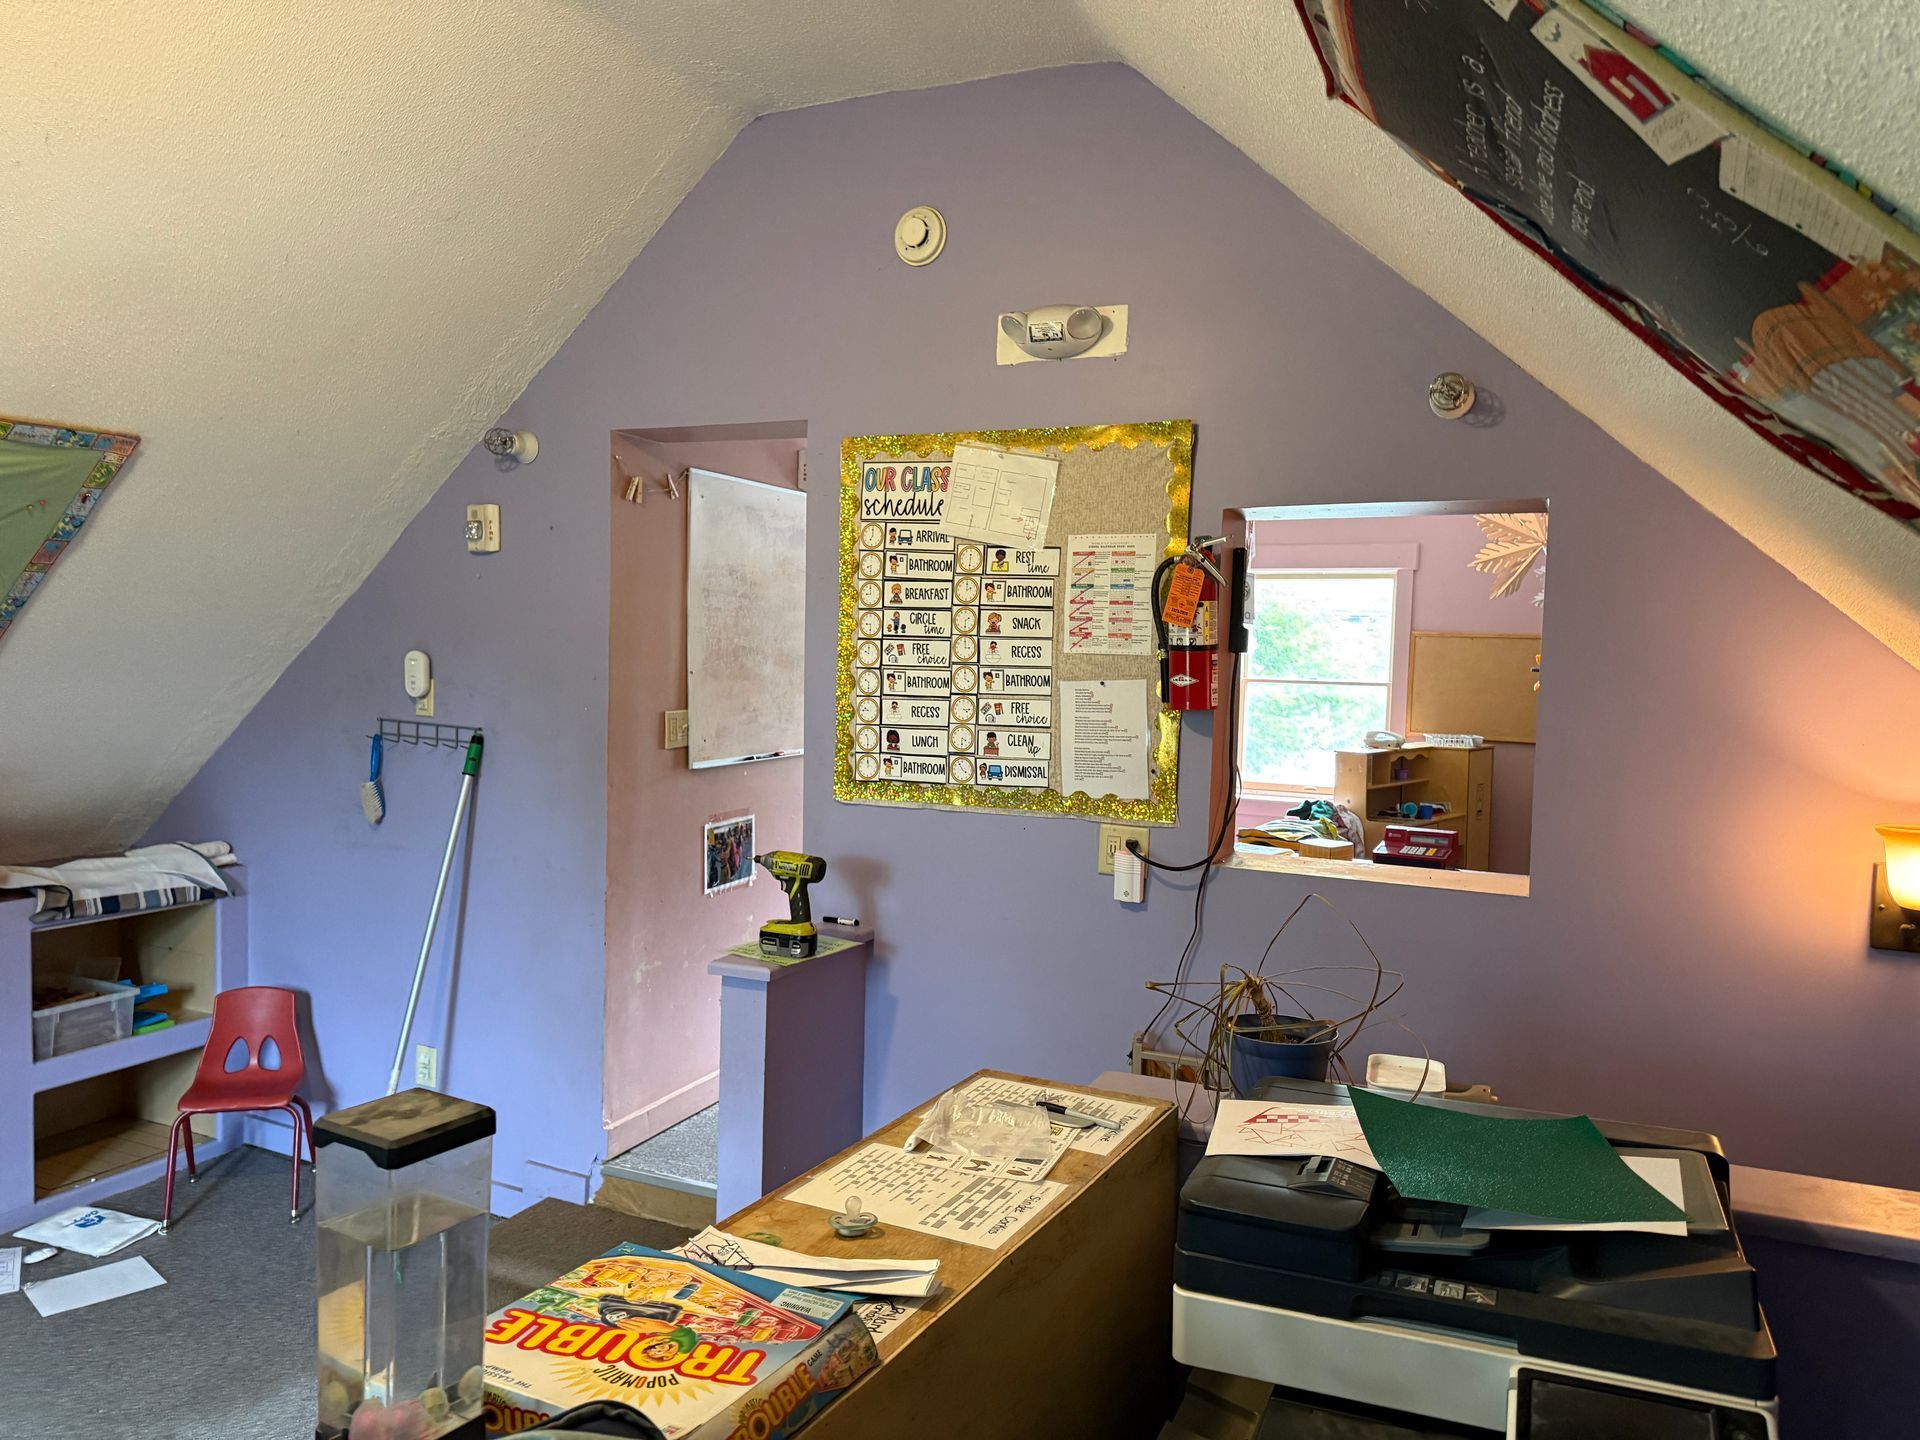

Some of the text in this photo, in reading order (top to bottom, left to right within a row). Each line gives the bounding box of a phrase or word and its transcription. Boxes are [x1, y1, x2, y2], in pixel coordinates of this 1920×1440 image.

[1491, 82, 1523, 147] friend
[864, 466, 950, 493] OUR CLASS
[864, 492, 943, 517] schedule
[915, 532, 950, 543] ARRIVAL
[1016, 550, 1036, 565] REST
[908, 558, 953, 573] BATHROOM
[1027, 560, 1050, 574] time
[904, 587, 950, 601] BREAKFAST
[1006, 585, 1053, 600] BATHROOM
[909, 611, 938, 626] CIRCLE
[1012, 617, 1041, 631] SNACK
[923, 621, 946, 636] time
[912, 642, 931, 655] FREE
[1011, 645, 1042, 659] RECESS
[917, 652, 948, 666] choice
[906, 676, 950, 690] BATHROOM
[1005, 674, 1051, 688] BATHROOM
[911, 705, 941, 719] RECESS
[1011, 703, 1031, 715] FREE
[1015, 712, 1048, 725] choice
[911, 735, 939, 748] LUNCH
[1007, 734, 1035, 747] CLEAN
[1028, 744, 1042, 755] up
[903, 762, 946, 776] BATHROOM
[1004, 765, 1048, 779] DISMISSAL
[779, 1300, 812, 1314] WARNING
[485, 1308, 767, 1386] TROUBLE
[807, 1350, 823, 1367] GAME
[515, 1377, 533, 1389] THE
[593, 1364, 680, 1389] POPOMATIC
[725, 1362, 817, 1440] ROUBLE
